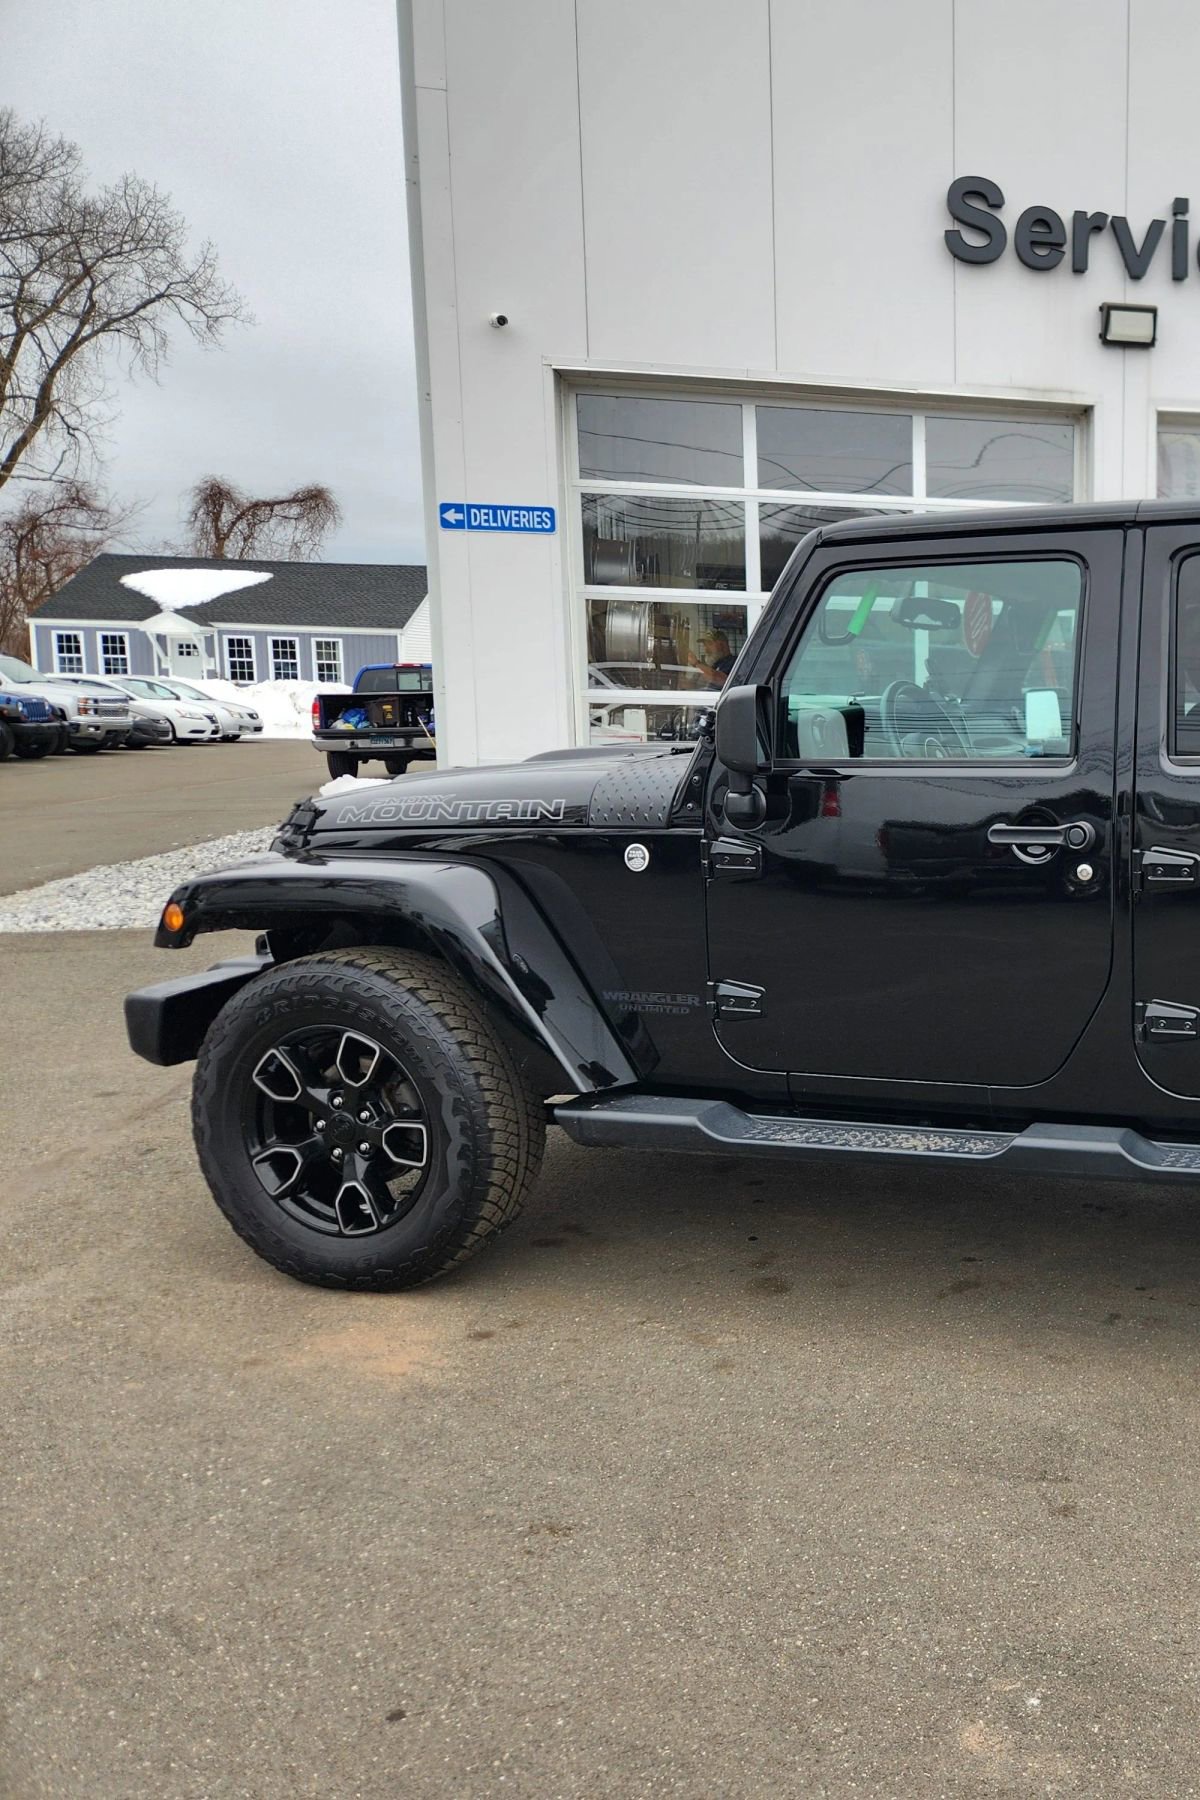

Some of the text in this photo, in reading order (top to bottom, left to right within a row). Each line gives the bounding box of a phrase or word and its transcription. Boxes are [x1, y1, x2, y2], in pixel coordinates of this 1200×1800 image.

[470, 508, 552, 529] DELIVERIES
[337, 798, 566, 824] MOUNTAIN
[601, 990, 700, 1006] WRANGLER
[619, 1003, 690, 1015] UNLIMITED
